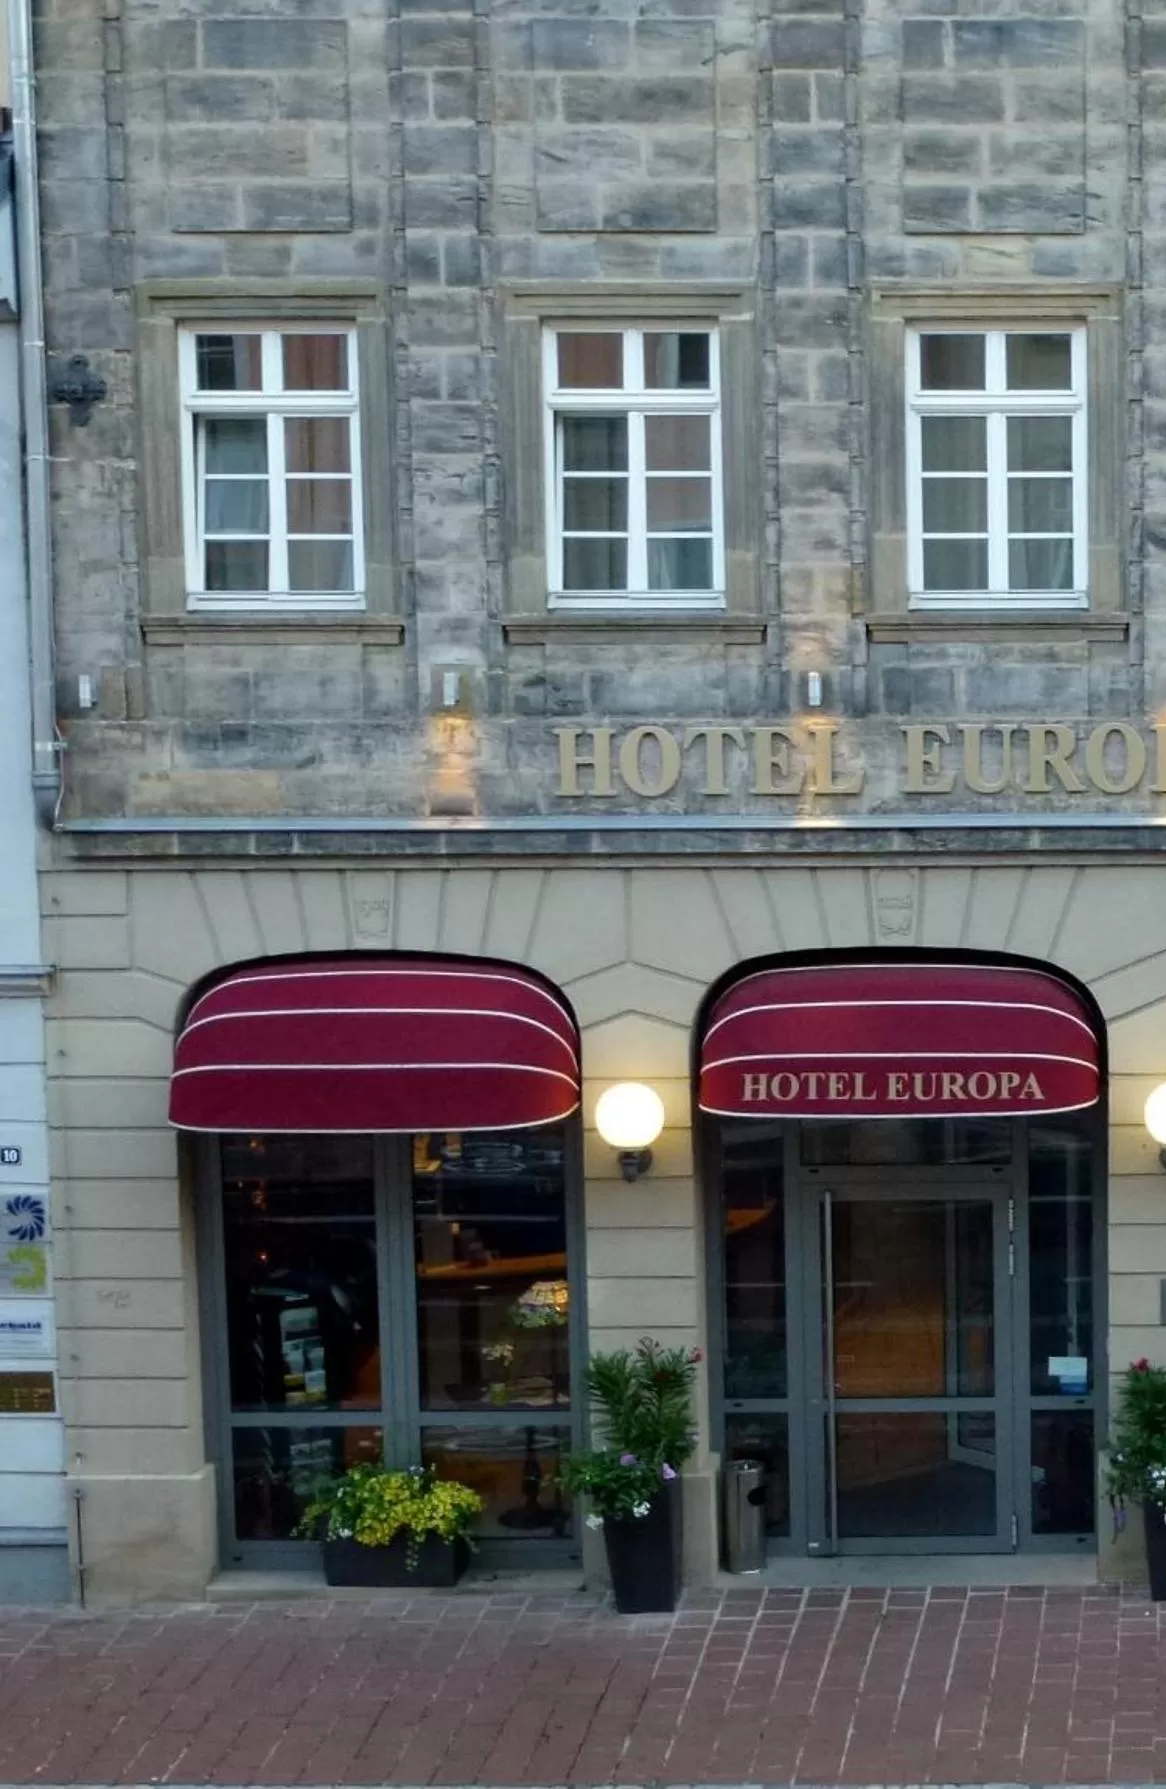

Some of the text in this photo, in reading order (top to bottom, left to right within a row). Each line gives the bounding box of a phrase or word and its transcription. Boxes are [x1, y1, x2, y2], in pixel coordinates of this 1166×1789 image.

[554, 725, 866, 798] HOTEL
[740, 1071, 1046, 1101] HOTEL EUROPA
[3, 1149, 18, 1162] 10
